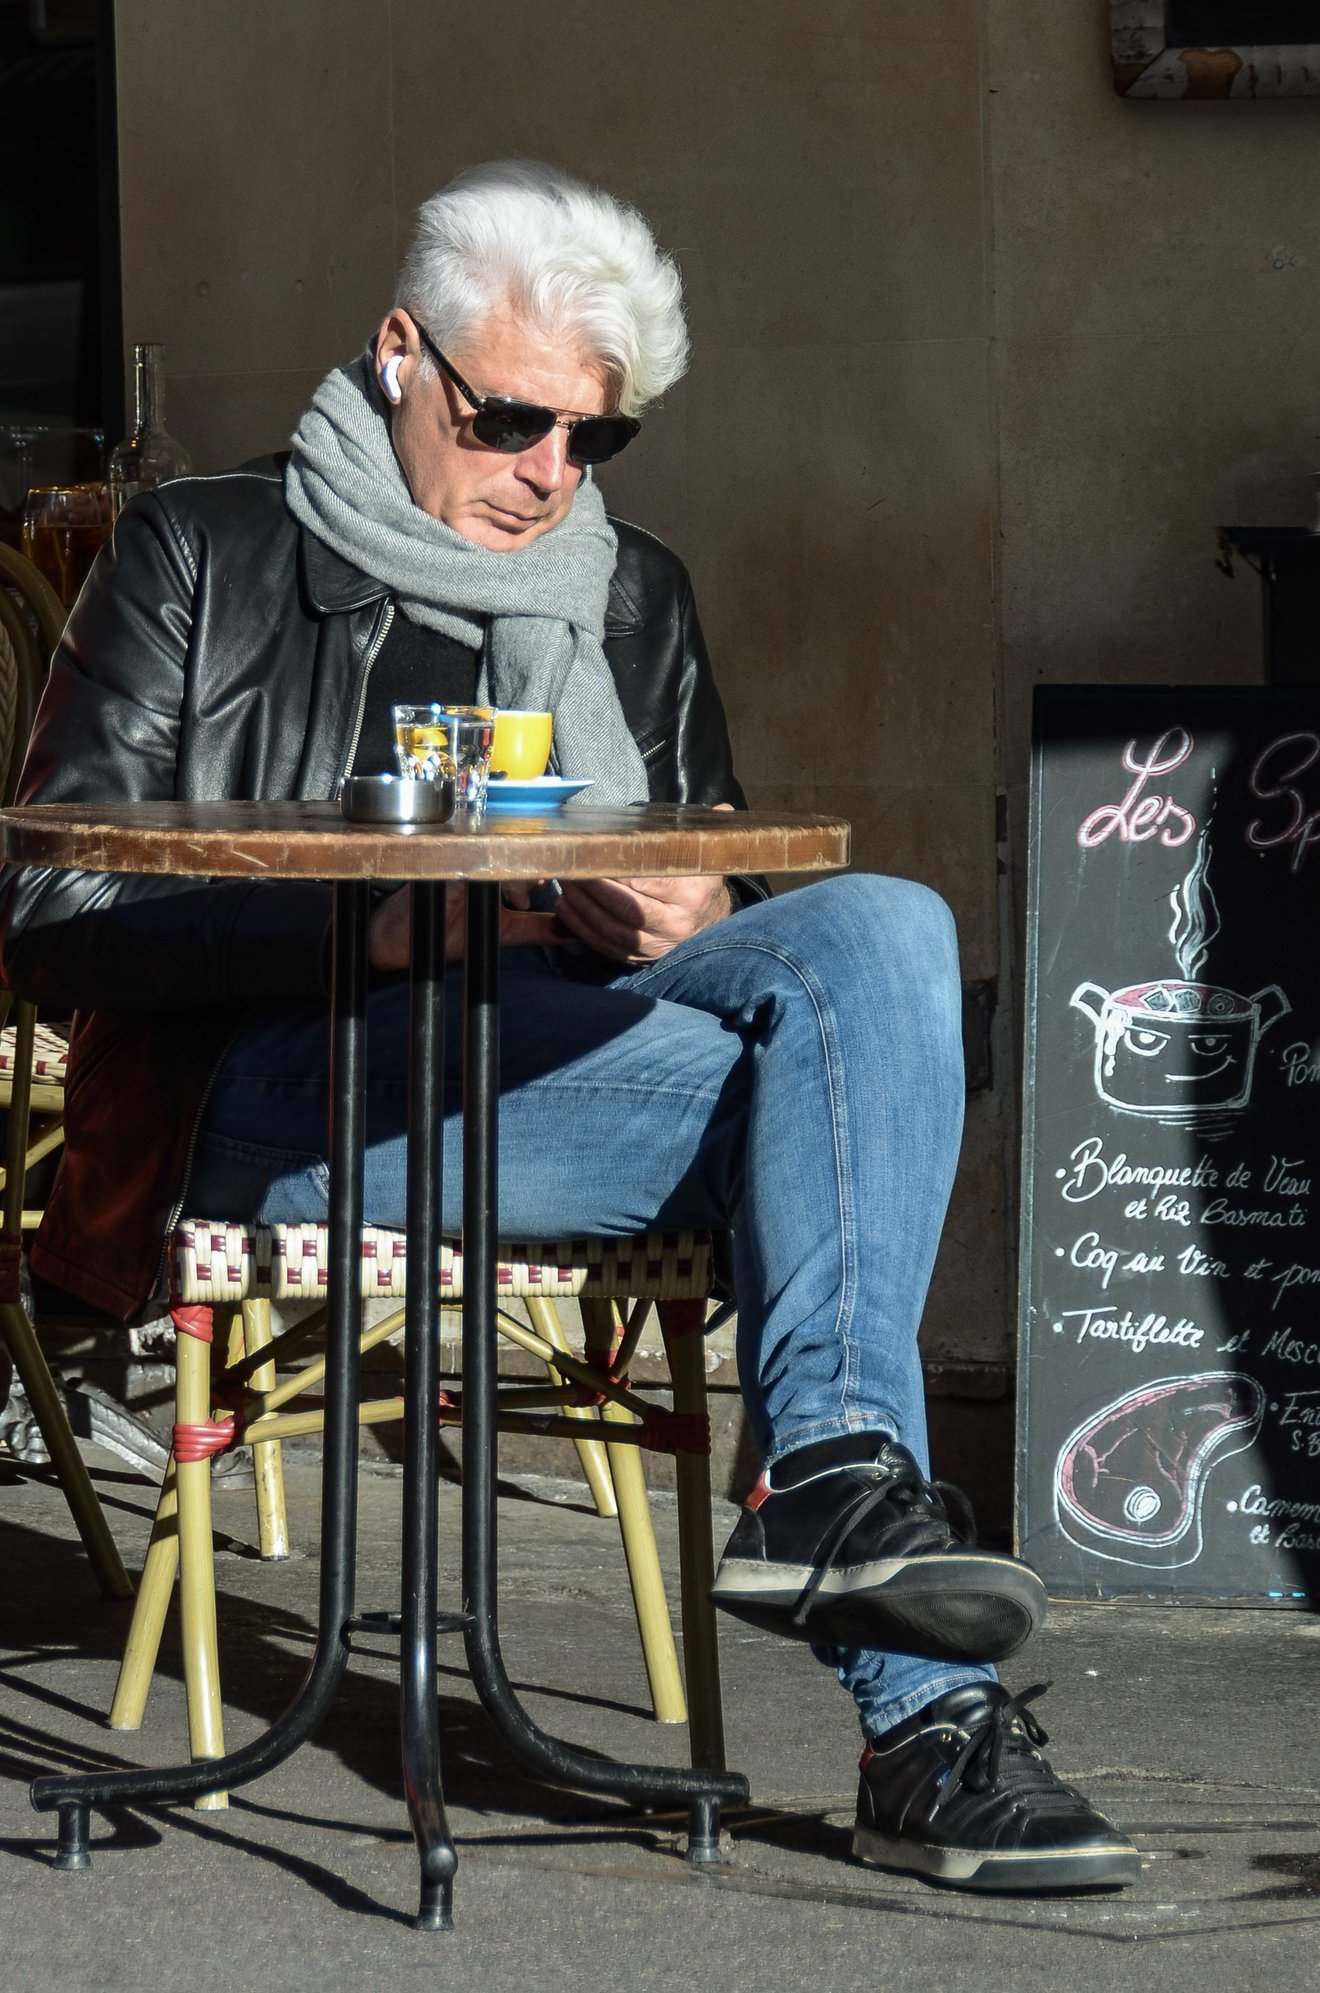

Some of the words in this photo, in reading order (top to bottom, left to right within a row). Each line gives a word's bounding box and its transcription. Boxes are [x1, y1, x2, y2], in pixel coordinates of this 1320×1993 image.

[1077, 725, 1196, 848] Les
[1061, 1136, 1218, 1203] Blanquette
[1226, 1162, 1251, 1189] de
[1263, 1154, 1311, 1196] Veau
[1124, 1198, 1148, 1220] et
[1200, 1198, 1308, 1227] Basmati
[1069, 1232, 1118, 1289] Coq
[1122, 1252, 1165, 1273] au
[1177, 1244, 1230, 1278] Vin
[1243, 1258, 1273, 1280] et
[1061, 1306, 1205, 1353] Tartiflette
[1216, 1329, 1251, 1353] et
[1260, 1326, 1320, 1365] Mesc
